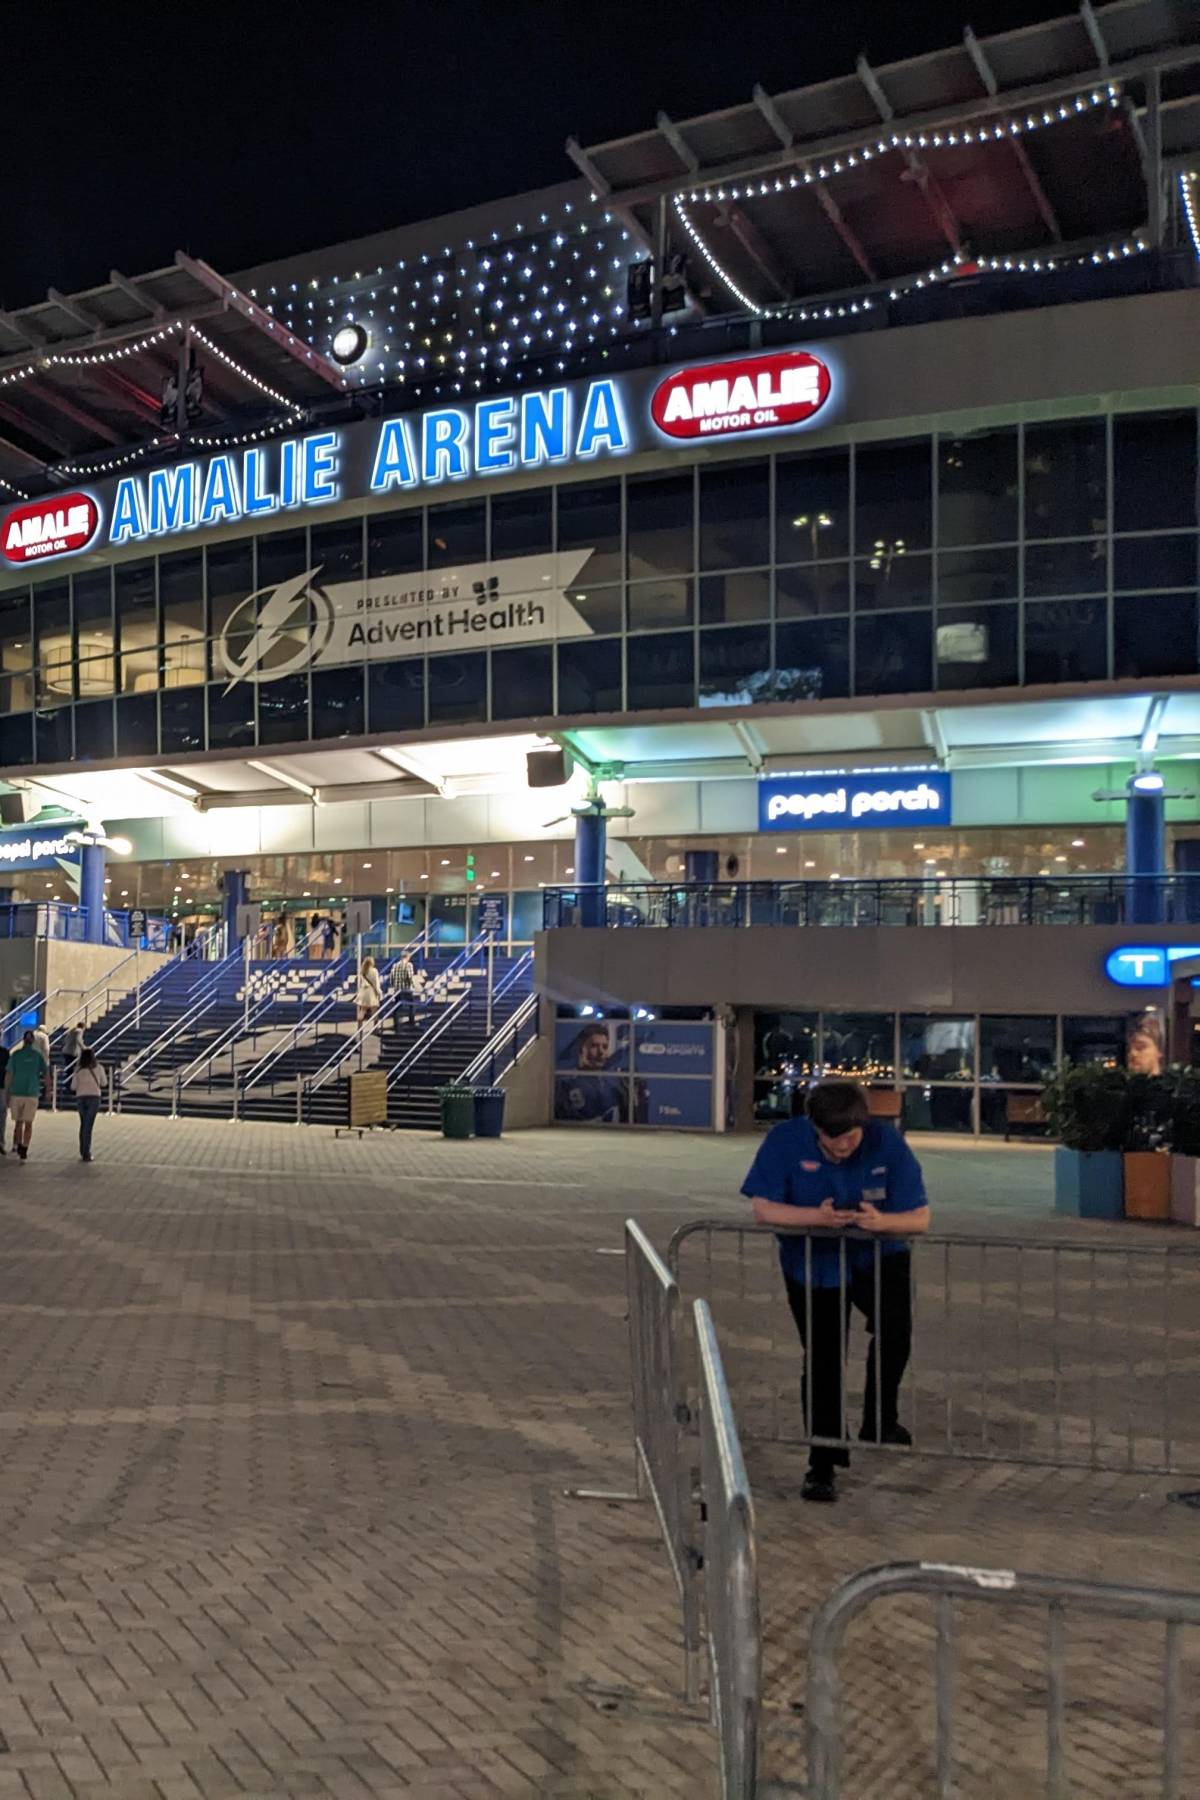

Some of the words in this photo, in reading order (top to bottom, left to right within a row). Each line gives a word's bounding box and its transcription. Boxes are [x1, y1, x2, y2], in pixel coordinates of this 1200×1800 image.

[664, 364, 820, 423] AMALIE
[699, 412, 751, 432] MOTOR
[753, 409, 779, 426] OIL
[109, 432, 339, 542] AMALIE
[370, 379, 628, 490] ARENA
[6, 504, 91, 550] AMALIE
[25, 542, 53, 557] MOTOR
[54, 541, 68, 553] OIL
[442, 586, 460, 599] BY
[347, 601, 545, 647] AdventHealth
[768, 788, 847, 820] pepsi
[851, 784, 940, 817] porch
